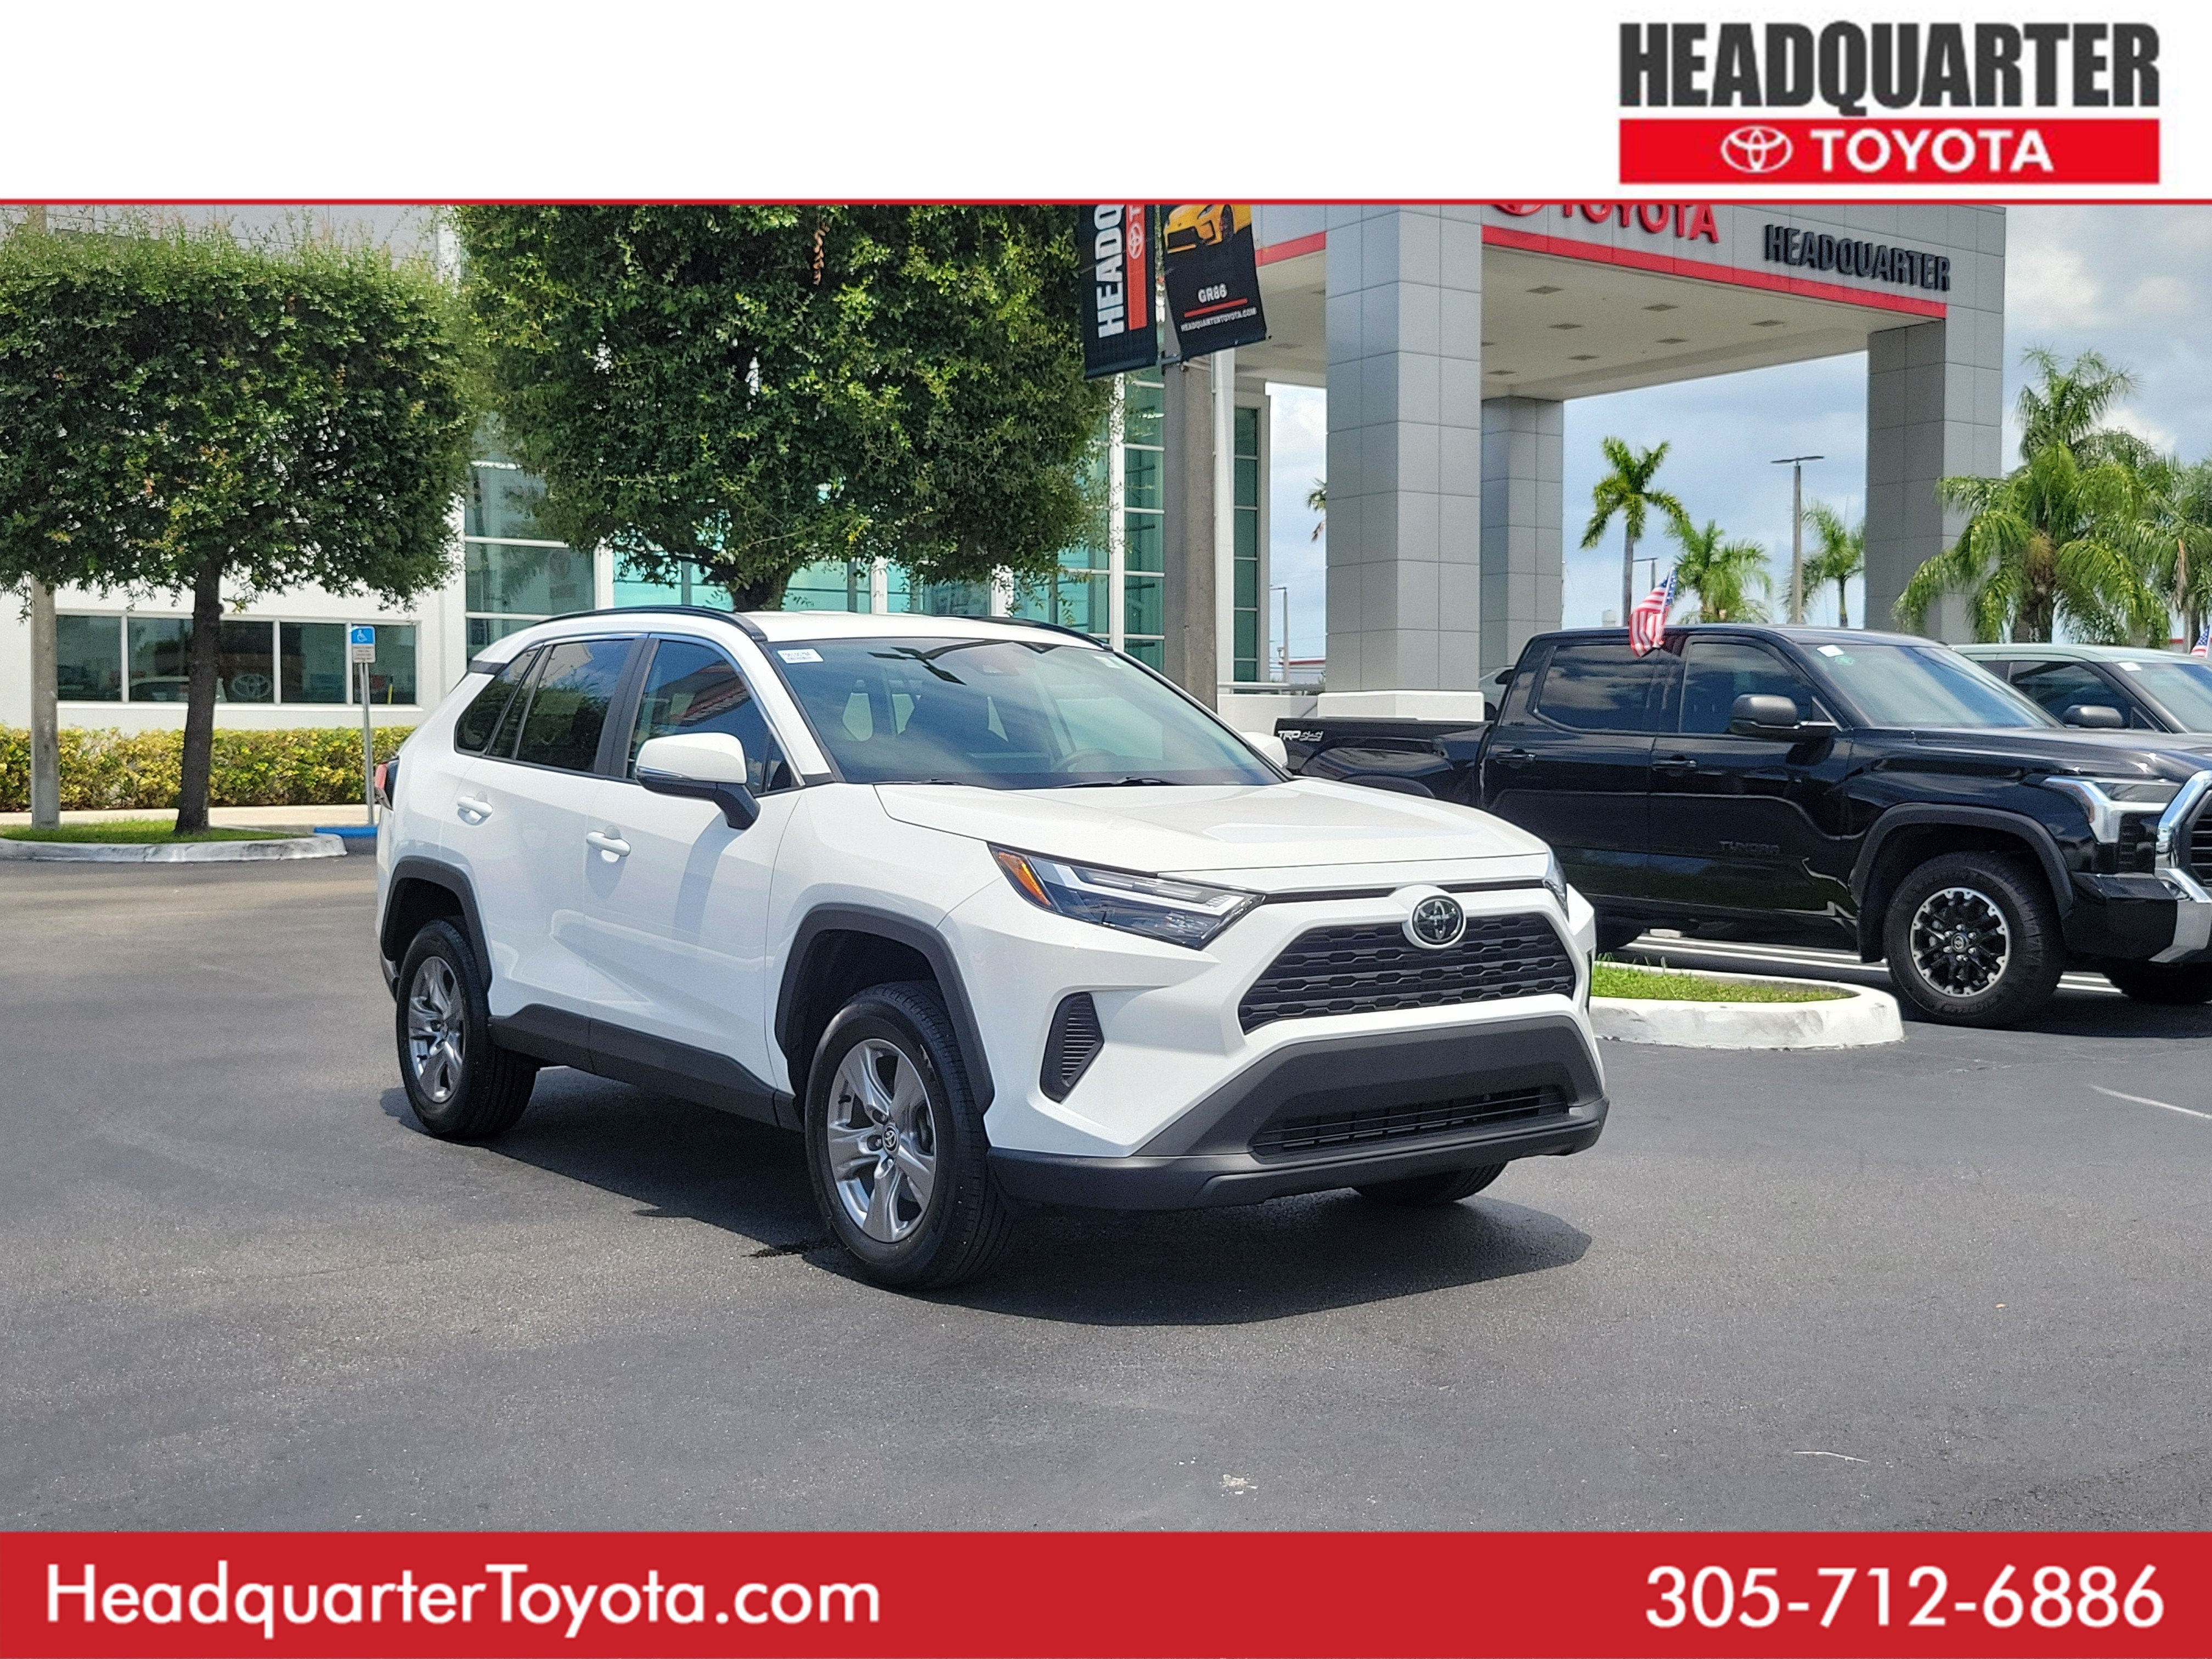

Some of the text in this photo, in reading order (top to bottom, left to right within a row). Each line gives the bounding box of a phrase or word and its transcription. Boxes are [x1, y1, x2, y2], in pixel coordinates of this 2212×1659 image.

[1764, 224, 1950, 291] HEADQUARTER
[1198, 283, 1228, 303] GR86
[1181, 307, 1257, 332] HEADQUARTERTOYOTA.COM
[1278, 730, 1301, 741] TRD
